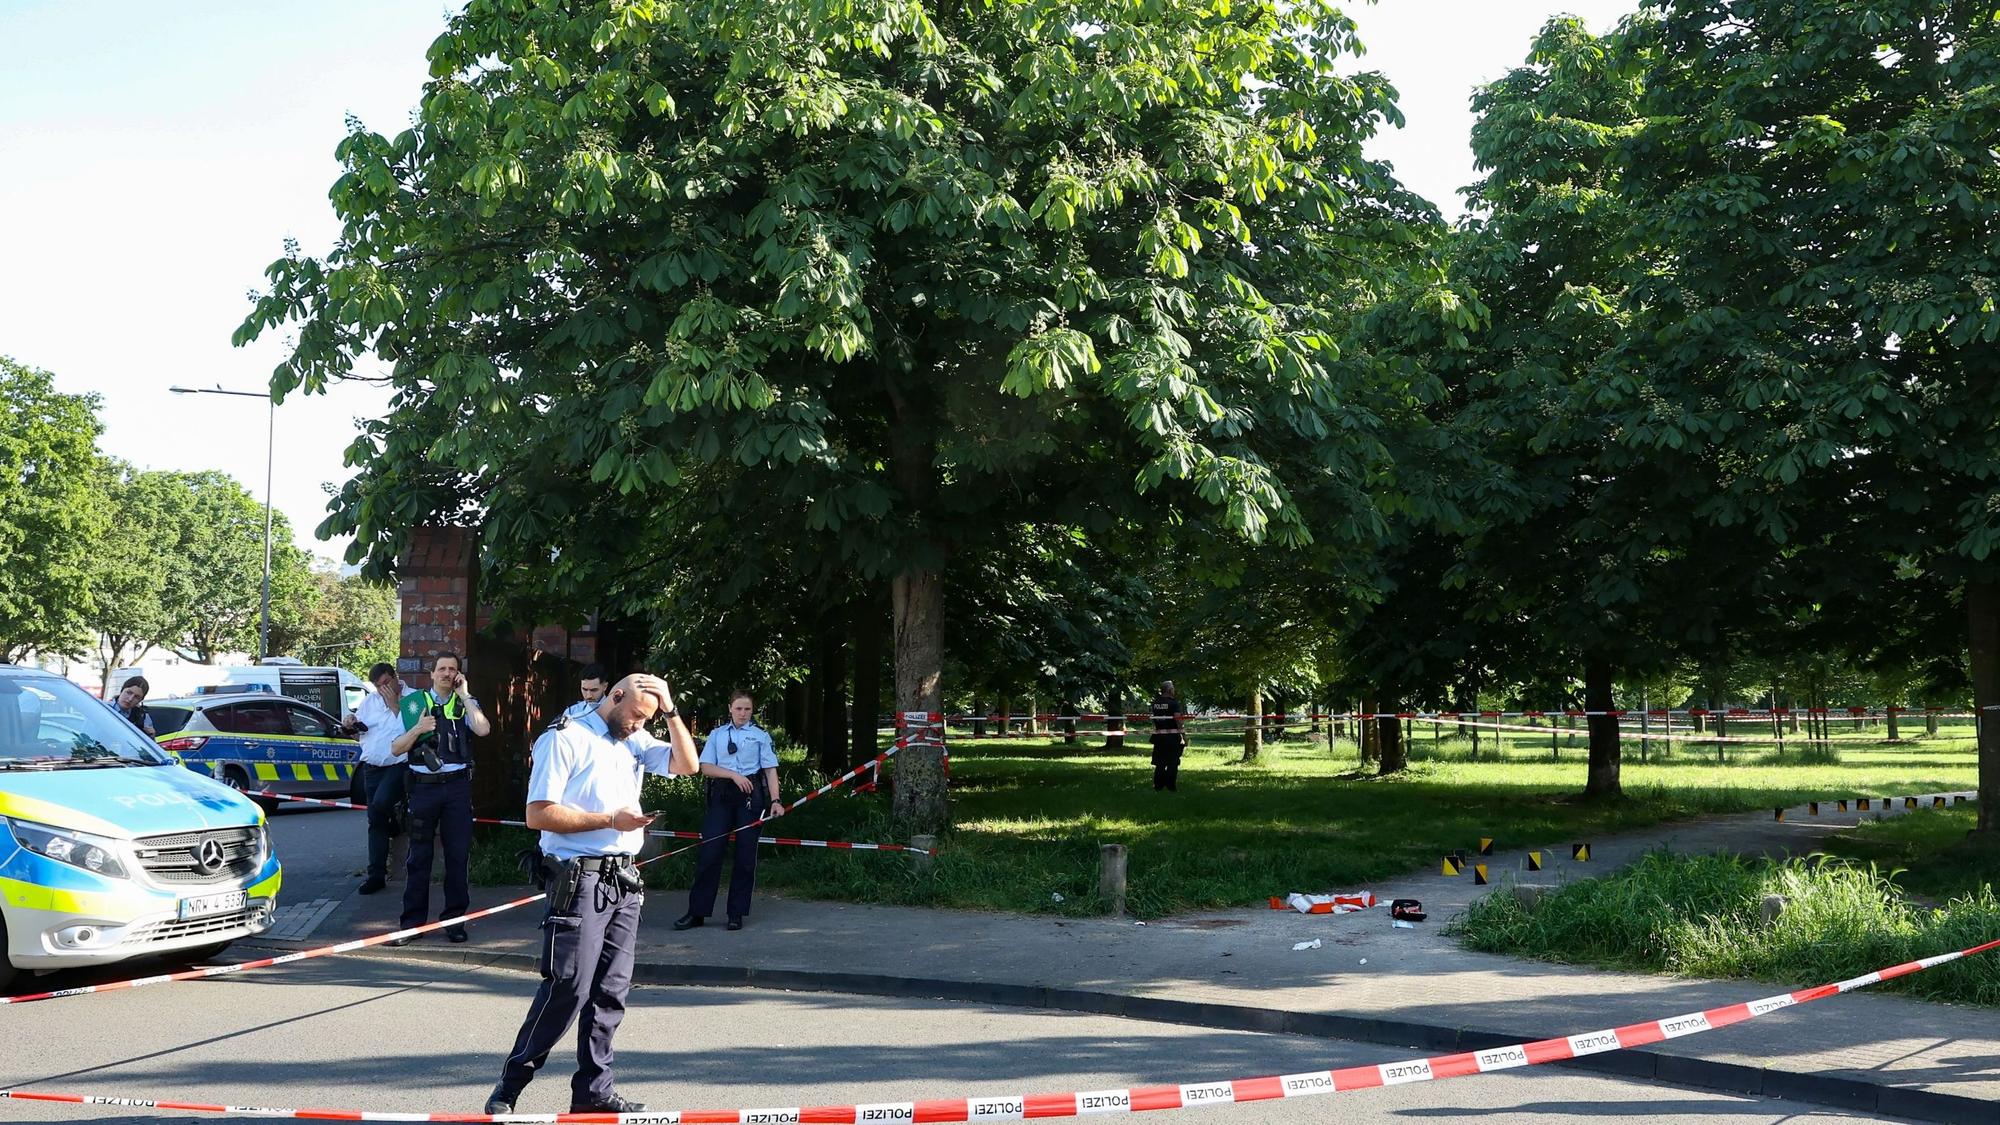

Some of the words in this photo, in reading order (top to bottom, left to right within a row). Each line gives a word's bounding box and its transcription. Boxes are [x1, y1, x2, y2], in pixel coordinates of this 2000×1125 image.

[312, 749, 341, 759] POLIZEI
[188, 898, 208, 913] NRW
[1665, 1017, 1707, 1032] POLIZEI
[1574, 1035, 1617, 1049] POLIZEI
[1482, 1050, 1525, 1065] POLIZEI
[1385, 1064, 1430, 1078] POLIZEI
[1287, 1076, 1332, 1089] POLIZEI
[1186, 1087, 1232, 1099] POLIZEI
[1082, 1095, 1129, 1108] POLIZEI
[863, 1108, 912, 1120] POLIZEI
[974, 1102, 1022, 1115] POLIZEI
[747, 1113, 797, 1123] POLIZEI
